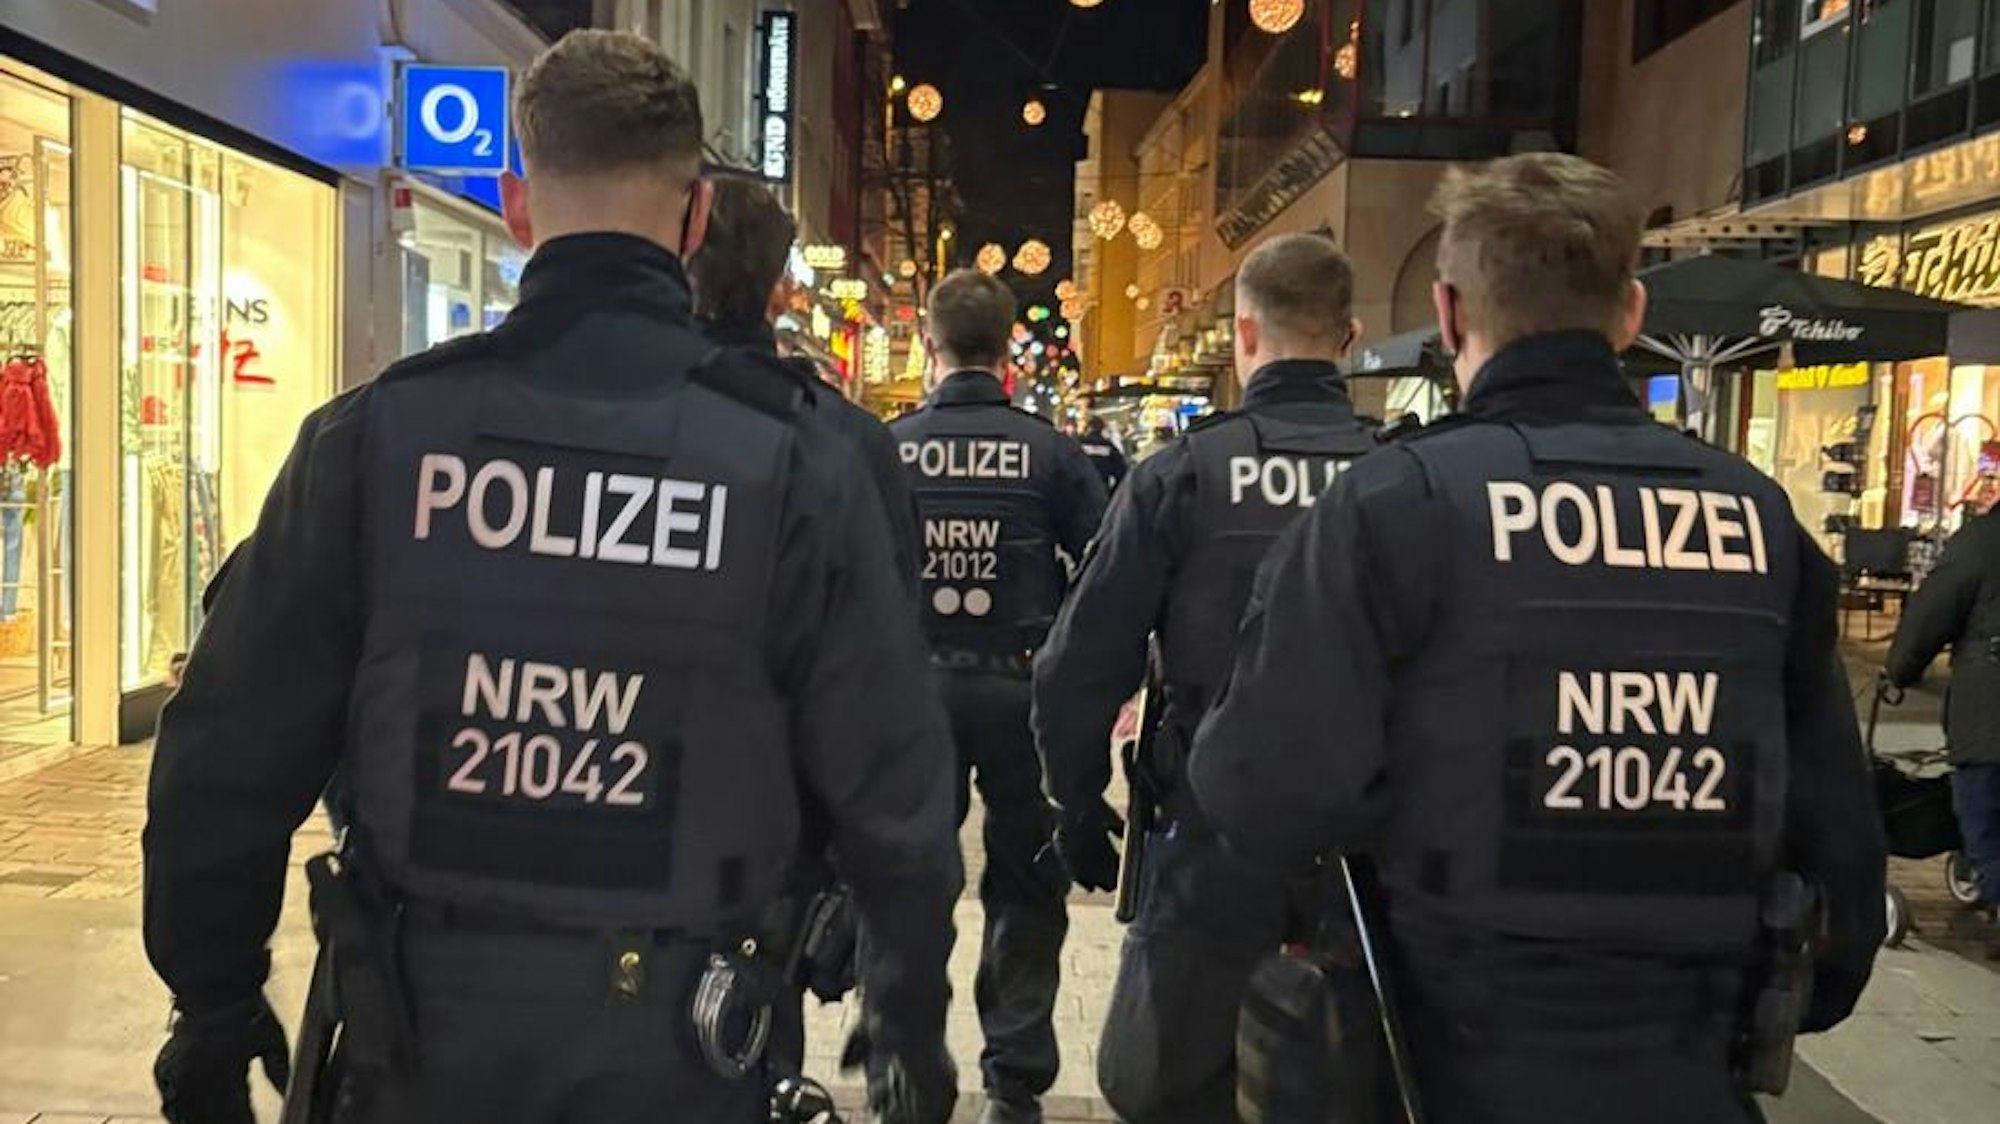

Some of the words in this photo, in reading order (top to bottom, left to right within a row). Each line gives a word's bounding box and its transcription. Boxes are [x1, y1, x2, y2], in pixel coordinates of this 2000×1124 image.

[1788, 318, 1865, 341] Tchibo
[899, 440, 1030, 479] POLIZEI
[1230, 456, 1352, 507] POLI
[414, 453, 728, 570] POLIZEI
[925, 519, 1000, 548] NRW
[1486, 480, 1768, 574] POLIZEI
[922, 551, 997, 579] 21012
[461, 652, 645, 735] NRW
[1557, 671, 1719, 735] NRW
[448, 727, 649, 806] 21042
[1544, 745, 1726, 811] 21042
